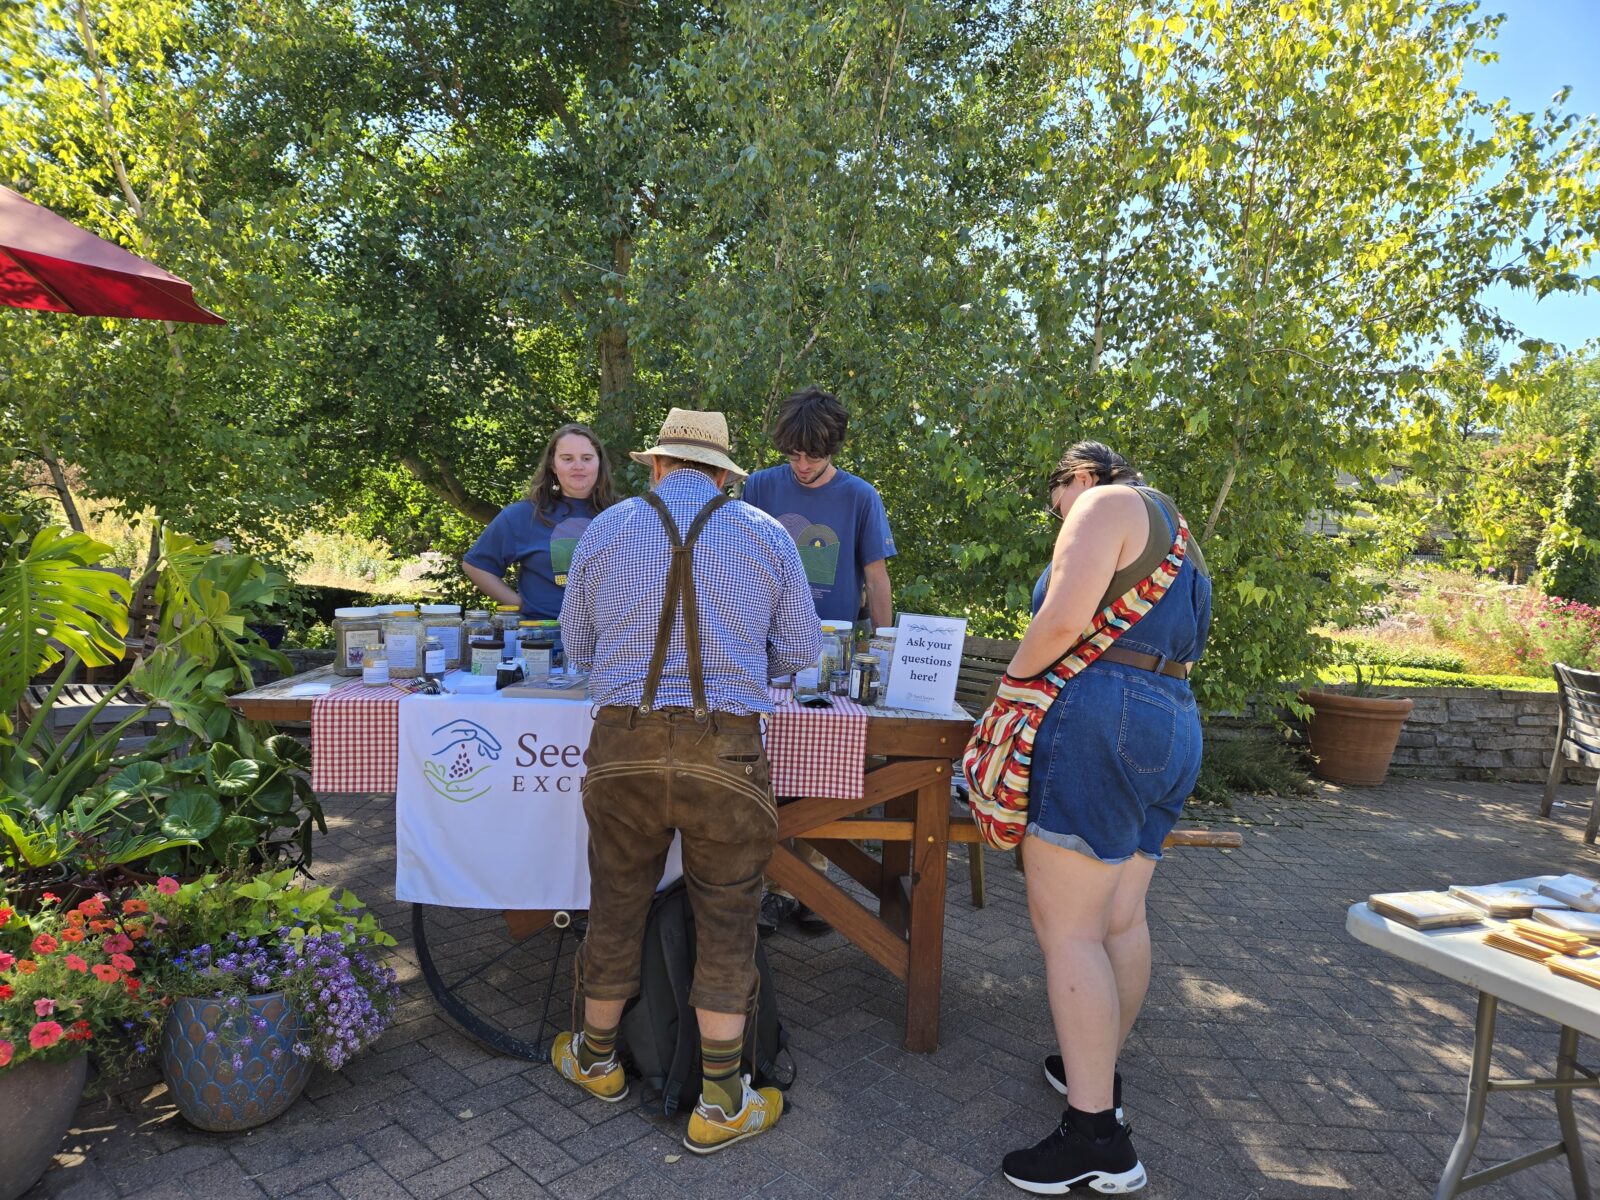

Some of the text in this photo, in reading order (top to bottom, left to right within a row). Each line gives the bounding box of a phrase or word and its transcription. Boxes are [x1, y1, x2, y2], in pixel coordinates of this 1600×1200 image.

[906, 637, 953, 651] Ask your
[901, 654, 953, 668] questions
[909, 669, 938, 683] here!
[515, 732, 588, 768] See
